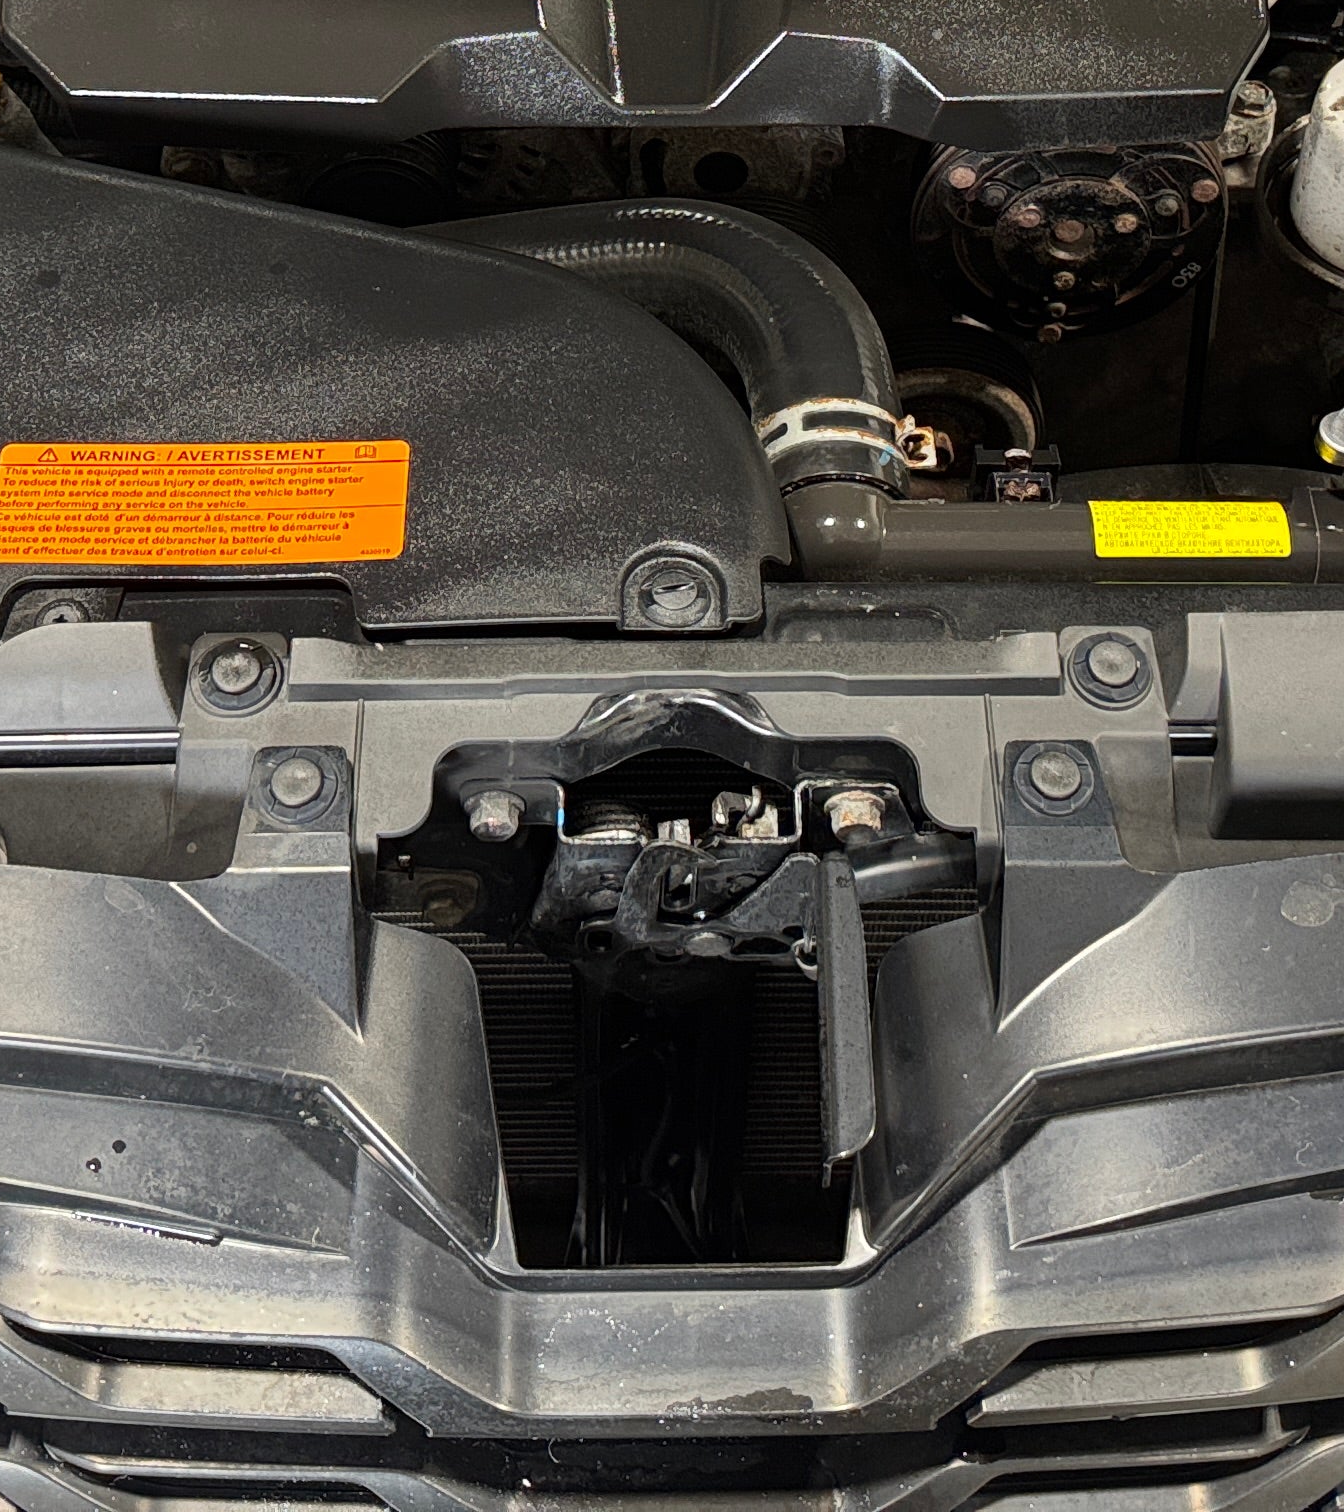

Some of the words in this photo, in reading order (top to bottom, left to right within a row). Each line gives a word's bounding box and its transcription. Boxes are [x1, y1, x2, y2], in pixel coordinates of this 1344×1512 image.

[176, 448, 326, 461] AVERTISSEMENT
[5, 467, 28, 475] This
[32, 467, 71, 475] vehicle
[87, 468, 138, 476] equipped
[219, 467, 274, 475] controlled
[277, 467, 313, 476] engine
[3, 478, 16, 486] To
[19, 478, 57, 486] reduce
[60, 478, 78, 486] the
[81, 478, 101, 486] risk
[105, 478, 117, 486] of
[249, 477, 284, 485] switch
[288, 477, 325, 486] engine
[328, 475, 364, 484] starter
[0, 490, 40, 498] system
[170, 489, 231, 497] disconnect
[234, 489, 251, 497] the
[254, 488, 293, 496] vehicle
[296, 488, 335, 497] battery
[37, 500, 99, 510] performing
[102, 502, 122, 510] any
[186, 500, 203, 508] the
[84, 513, 109, 521] doté
[115, 513, 140, 521] d'un
[143, 512, 200, 521] démarreur
[267, 512, 293, 521] Pour
[296, 511, 335, 520] réduire
[339, 511, 355, 519] les
[38, 524, 52, 532] de
[55, 524, 110, 532] blessures
[114, 525, 151, 534] graves
[155, 525, 169, 533] ou
[231, 525, 267, 533] mettre
[269, 524, 279, 532] le
[282, 523, 339, 532] démarreur
[94, 536, 135, 544] service
[138, 536, 149, 544] et
[152, 535, 215, 544] débrancher
[219, 536, 229, 544] la
[231, 536, 275, 544] batterie
[278, 535, 292, 543] du
[295, 533, 342, 543] véhicule
[22, 546, 85, 555] d'effectuer
[87, 547, 107, 555] des
[110, 547, 153, 555] travaux
[220, 547, 238, 555] sur
